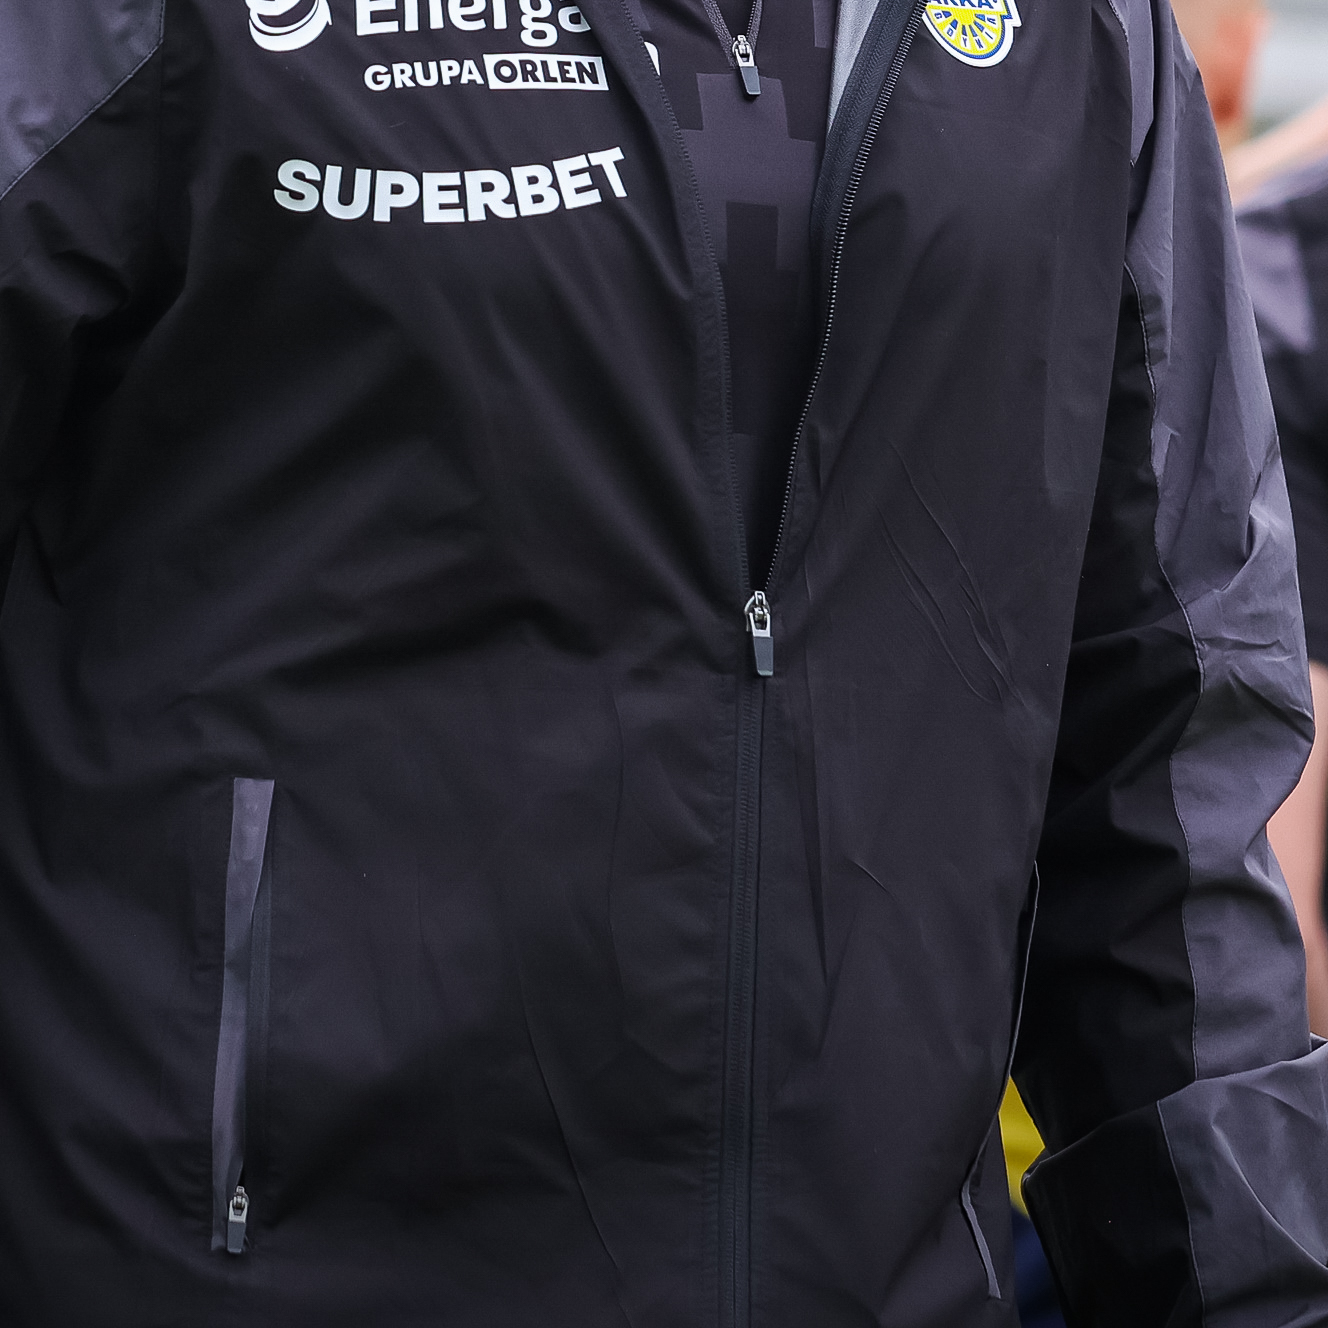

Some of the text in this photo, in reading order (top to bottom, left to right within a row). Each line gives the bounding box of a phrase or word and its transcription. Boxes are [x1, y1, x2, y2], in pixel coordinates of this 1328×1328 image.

[363, 58, 600, 91] GRUPA ORLEN
[273, 146, 628, 223] SUPERBET
